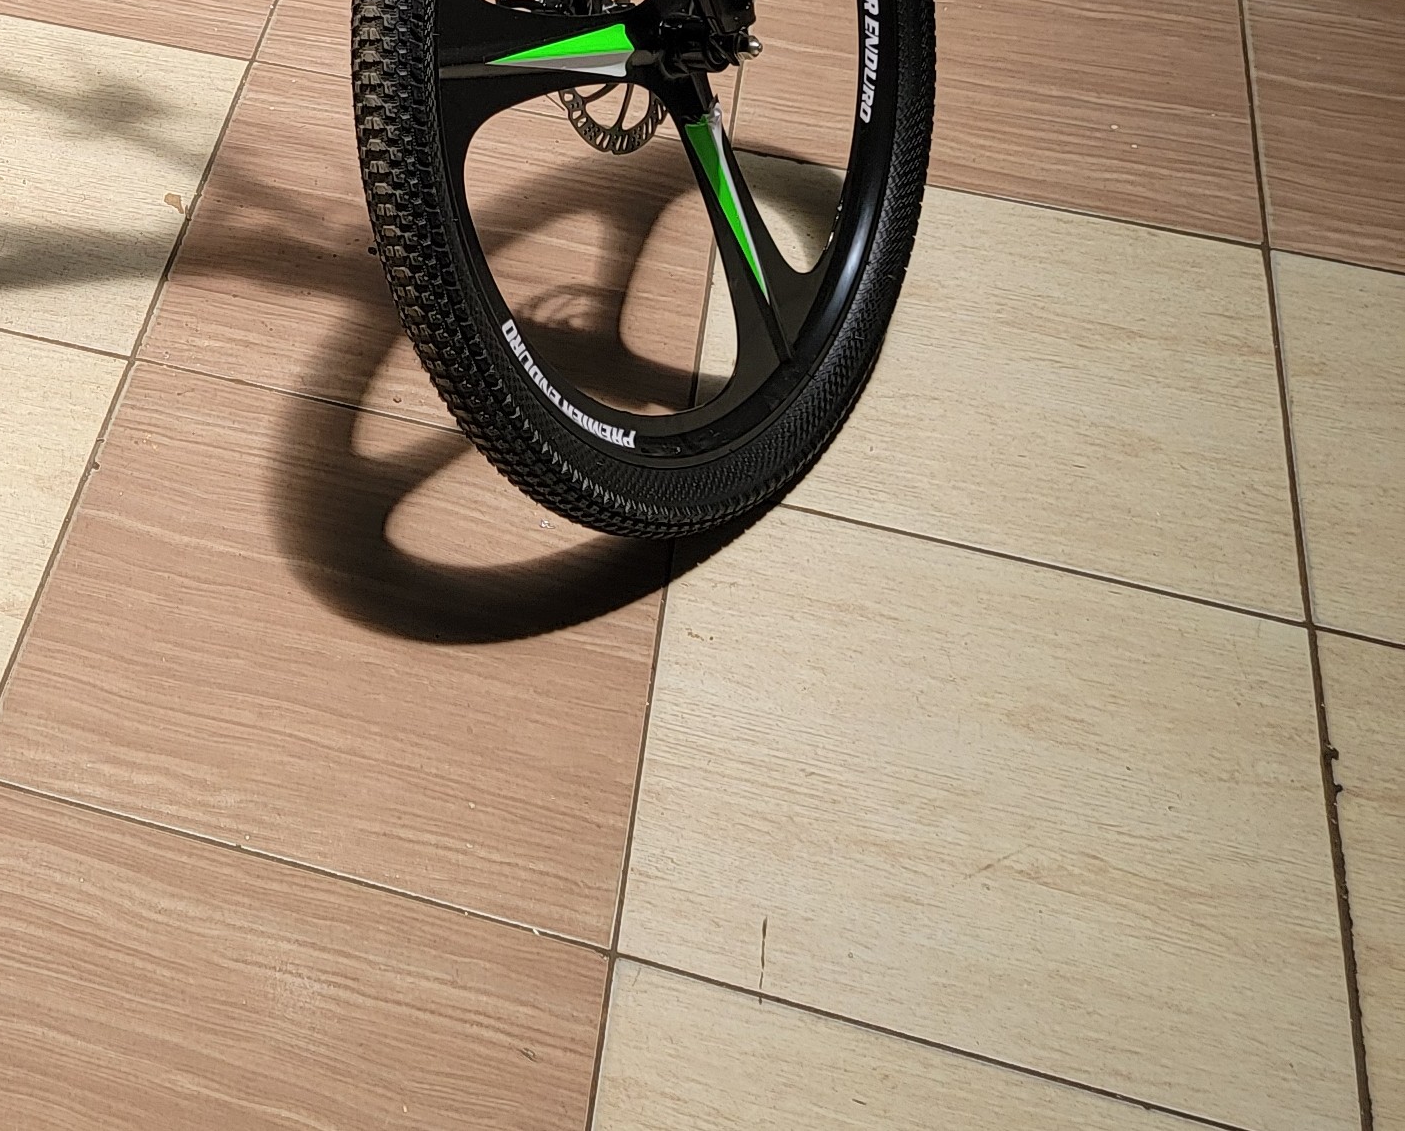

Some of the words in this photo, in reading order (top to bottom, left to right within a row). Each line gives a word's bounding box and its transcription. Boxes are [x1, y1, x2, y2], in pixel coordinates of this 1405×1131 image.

[859, 15, 880, 124] ENDURO
[501, 318, 563, 406] ENDURO
[560, 400, 637, 449] PREMIER
